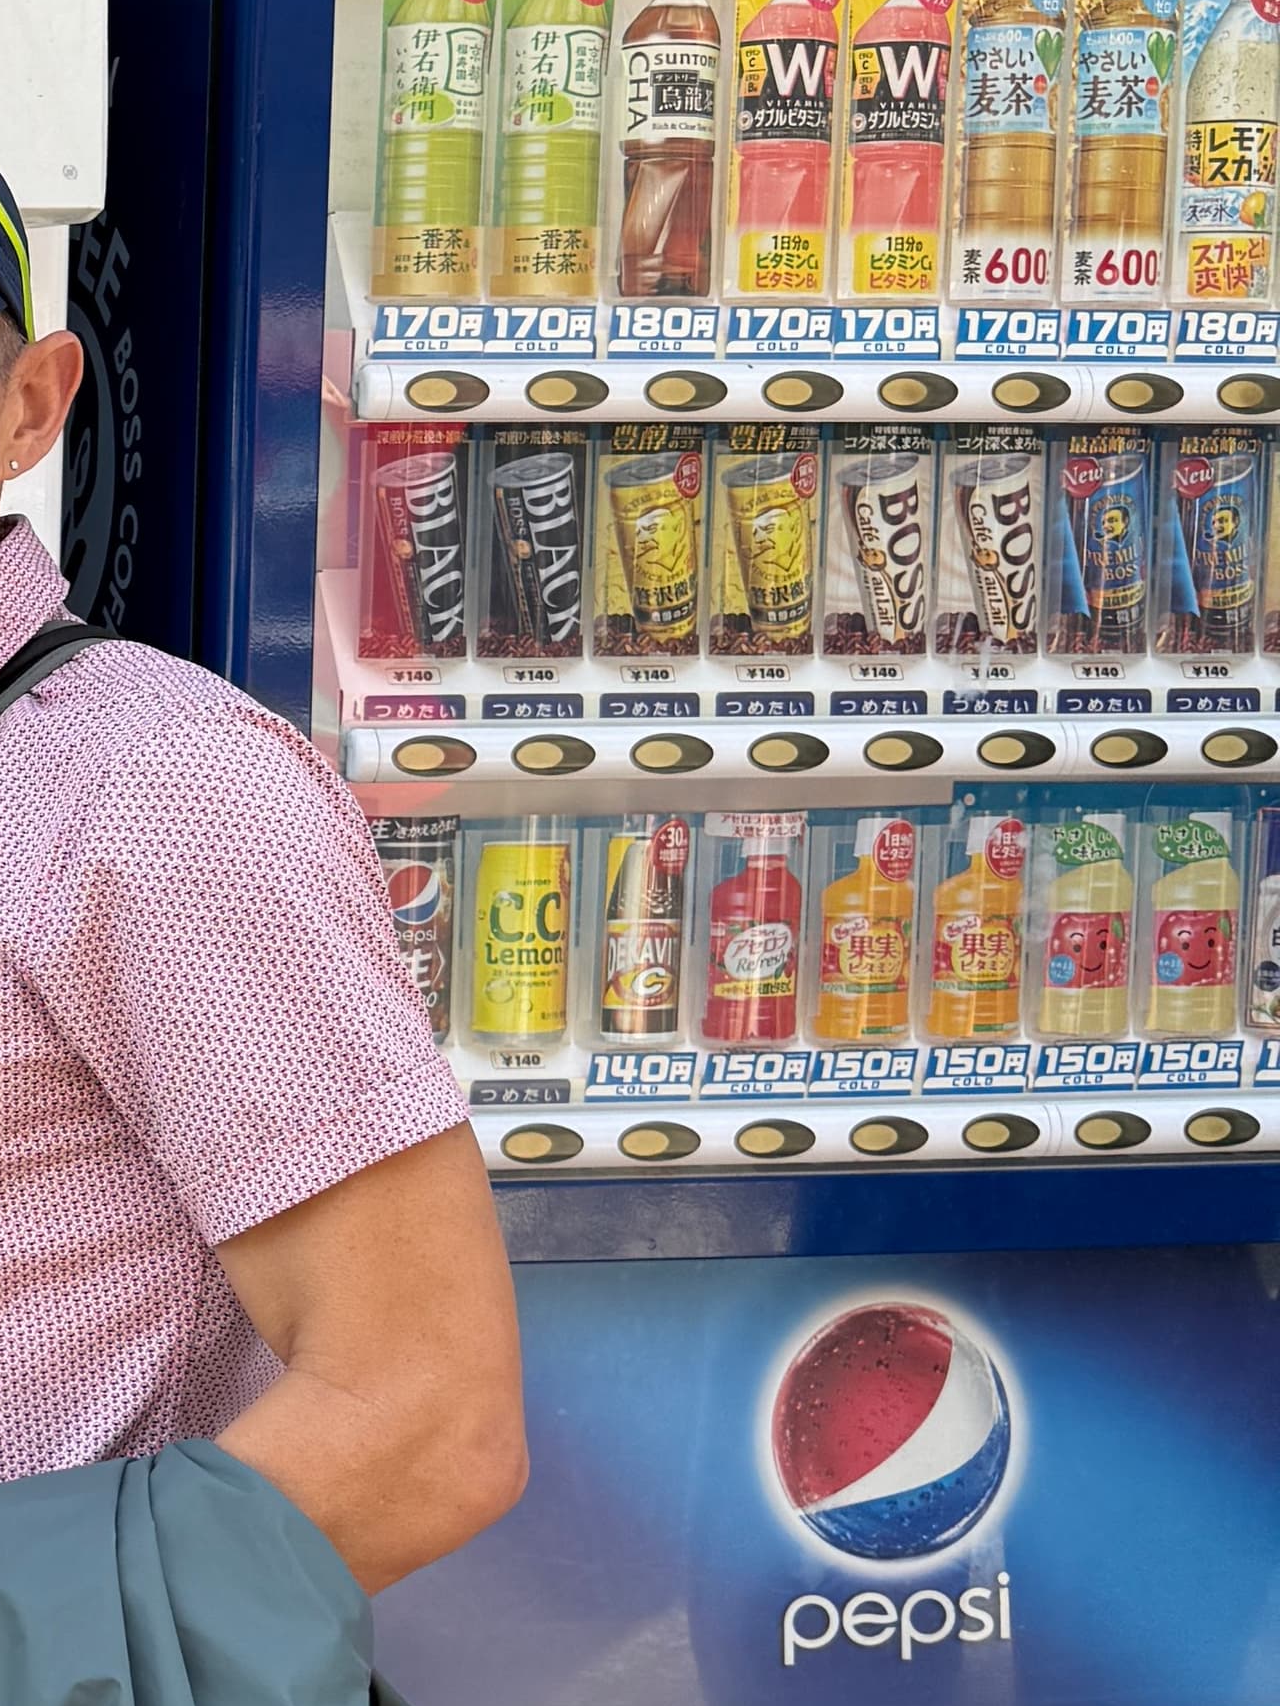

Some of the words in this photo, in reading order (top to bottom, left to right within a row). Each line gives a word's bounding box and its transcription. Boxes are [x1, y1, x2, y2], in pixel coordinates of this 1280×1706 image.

[766, 43, 827, 97] W
[879, 45, 940, 100] W
[968, 47, 1034, 71] やさしい
[1080, 49, 1146, 73] やさしい
[410, 28, 441, 121] 伊右衛門
[530, 30, 561, 122] 伊右衛門
[627, 51, 650, 133] CHA
[967, 72, 1035, 118] 麦茶
[1077, 75, 1146, 121] 麦茶
[1208, 126, 1271, 153] レモン
[963, 248, 981, 284] 麦茶
[1073, 249, 1092, 286] 麦茶
[383, 308, 483, 340] 170円
[493, 308, 591, 340] 170円
[615, 308, 713, 340] 180円
[735, 308, 832, 340] 170円
[844, 307, 934, 341] 170円
[966, 310, 1057, 342] 170円
[1076, 311, 1168, 343] 170円
[1183, 311, 1278, 343] 180円
[1204, 344, 1246, 356] COLD
[1062, 466, 1103, 490] New
[1171, 466, 1215, 490] New
[854, 502, 877, 544] Café
[968, 502, 990, 544] Café
[404, 471, 464, 643] BLACK
[522, 471, 582, 643] BLACK
[878, 479, 926, 632] BOSS
[992, 479, 1040, 632] BOSS
[746, 667, 786, 681] ¥140
[858, 666, 898, 679] ¥140
[1081, 665, 1120, 678] ¥140
[1192, 665, 1229, 678] ¥140
[609, 701, 691, 717] つめたい
[725, 700, 807, 716] つめたい
[842, 698, 920, 715] つめたい
[951, 697, 1031, 714] つめたい
[1066, 697, 1145, 713] つめたい
[1175, 697, 1255, 713] つめたい
[484, 942, 564, 965] Lemon
[847, 934, 899, 959] 果実
[959, 932, 1010, 958] 果実
[631, 966, 666, 997] C
[501, 1054, 541, 1067] ¥140
[594, 1053, 695, 1085] 140円
[711, 1052, 808, 1083] 150円
[820, 1049, 915, 1081] 150円
[934, 1047, 1028, 1076] 150円
[1045, 1044, 1137, 1074] 150円
[1149, 1042, 1237, 1072] 150円
[615, 1084, 659, 1097] COLD
[729, 1082, 774, 1095] COLD
[838, 1079, 881, 1091] COLD
[952, 1075, 995, 1088] COLD
[1062, 1074, 1104, 1086] COLD
[1167, 1072, 1208, 1083] COLD
[480, 1087, 561, 1104] つめたい
[782, 1571, 1012, 1666] pepsi
